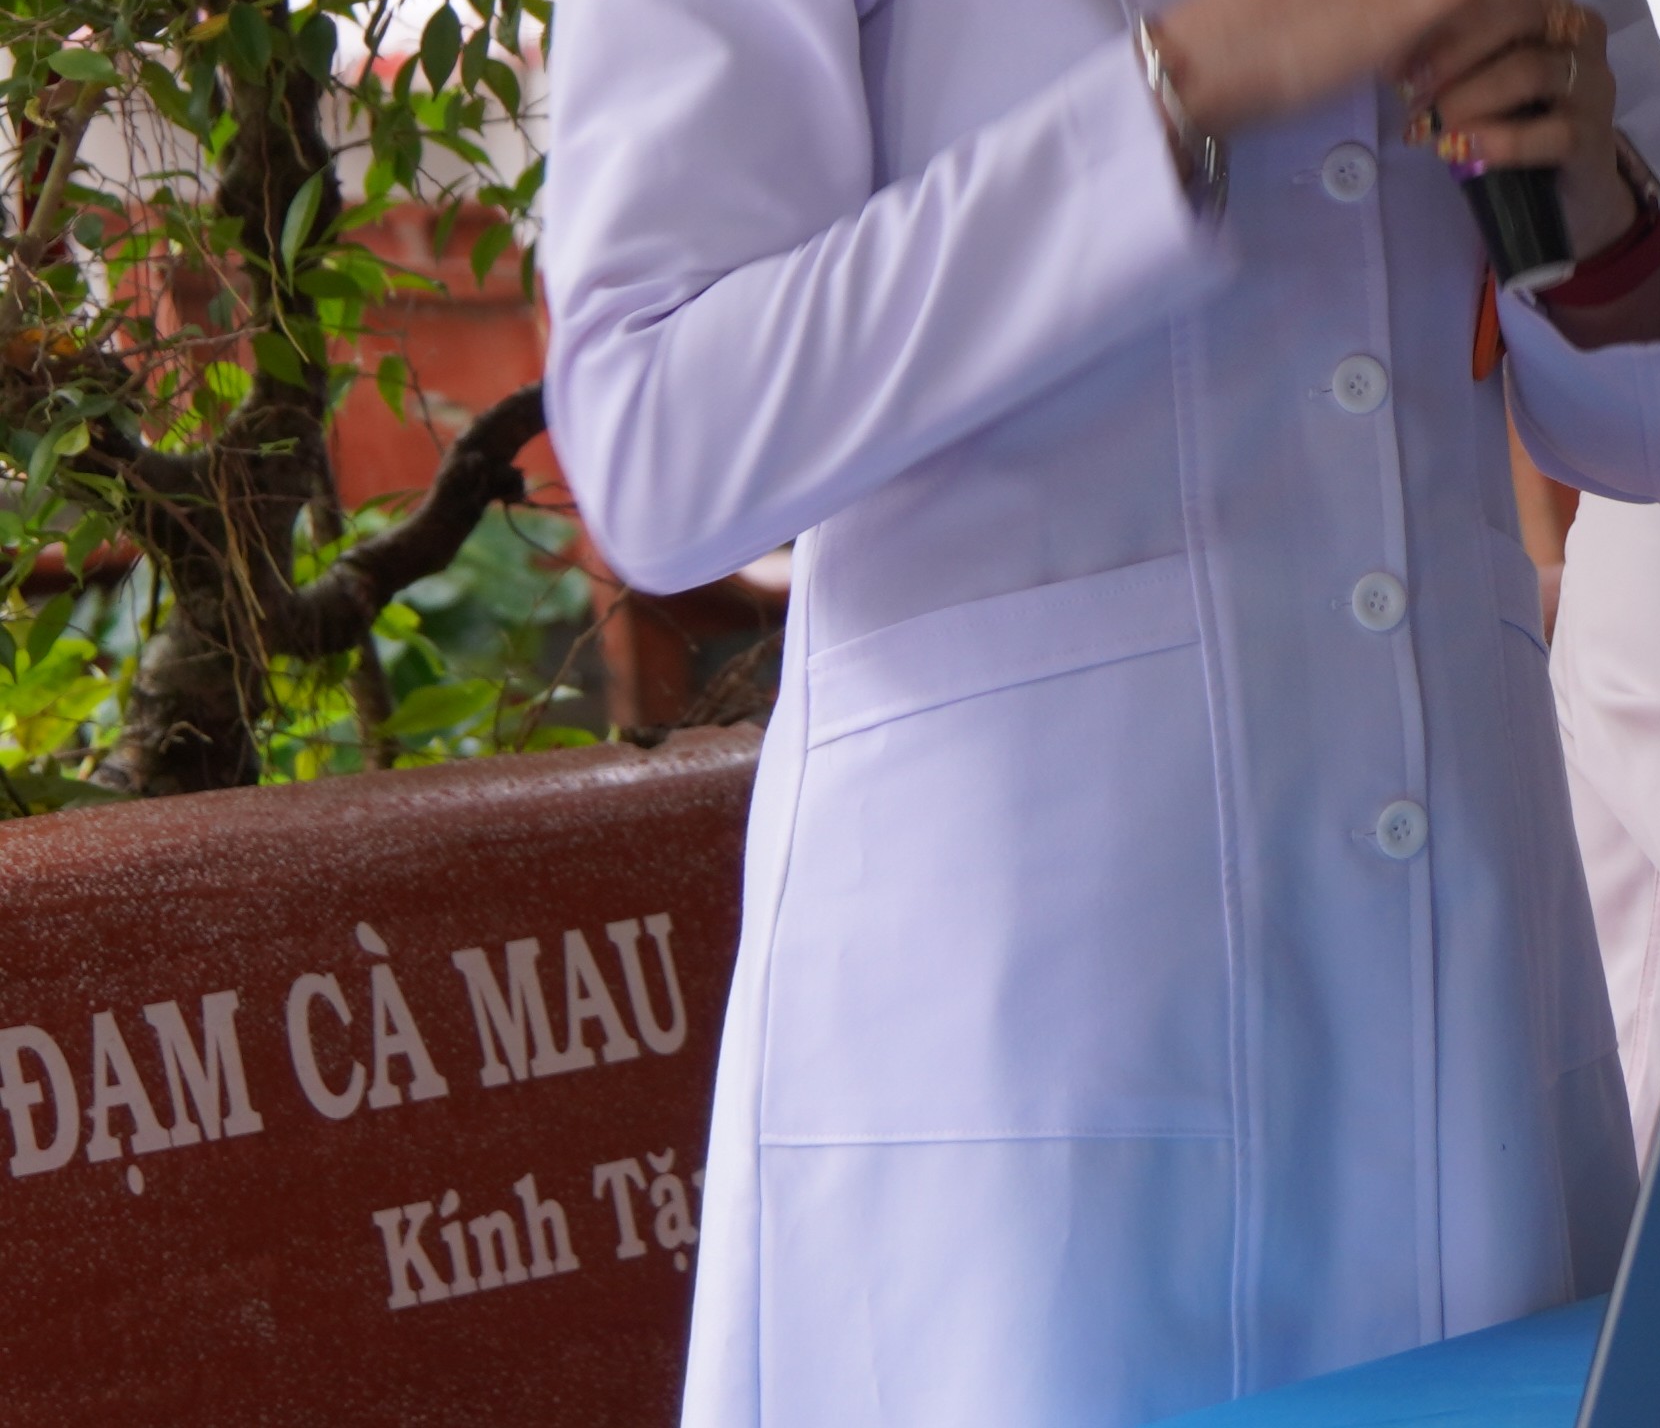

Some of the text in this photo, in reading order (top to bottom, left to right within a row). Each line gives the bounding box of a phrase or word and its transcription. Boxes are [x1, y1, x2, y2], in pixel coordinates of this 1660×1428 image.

[0, 912, 689, 1196] ĐẠM CÀ MAU
[372, 1147, 708, 1310] Kính Tặ
